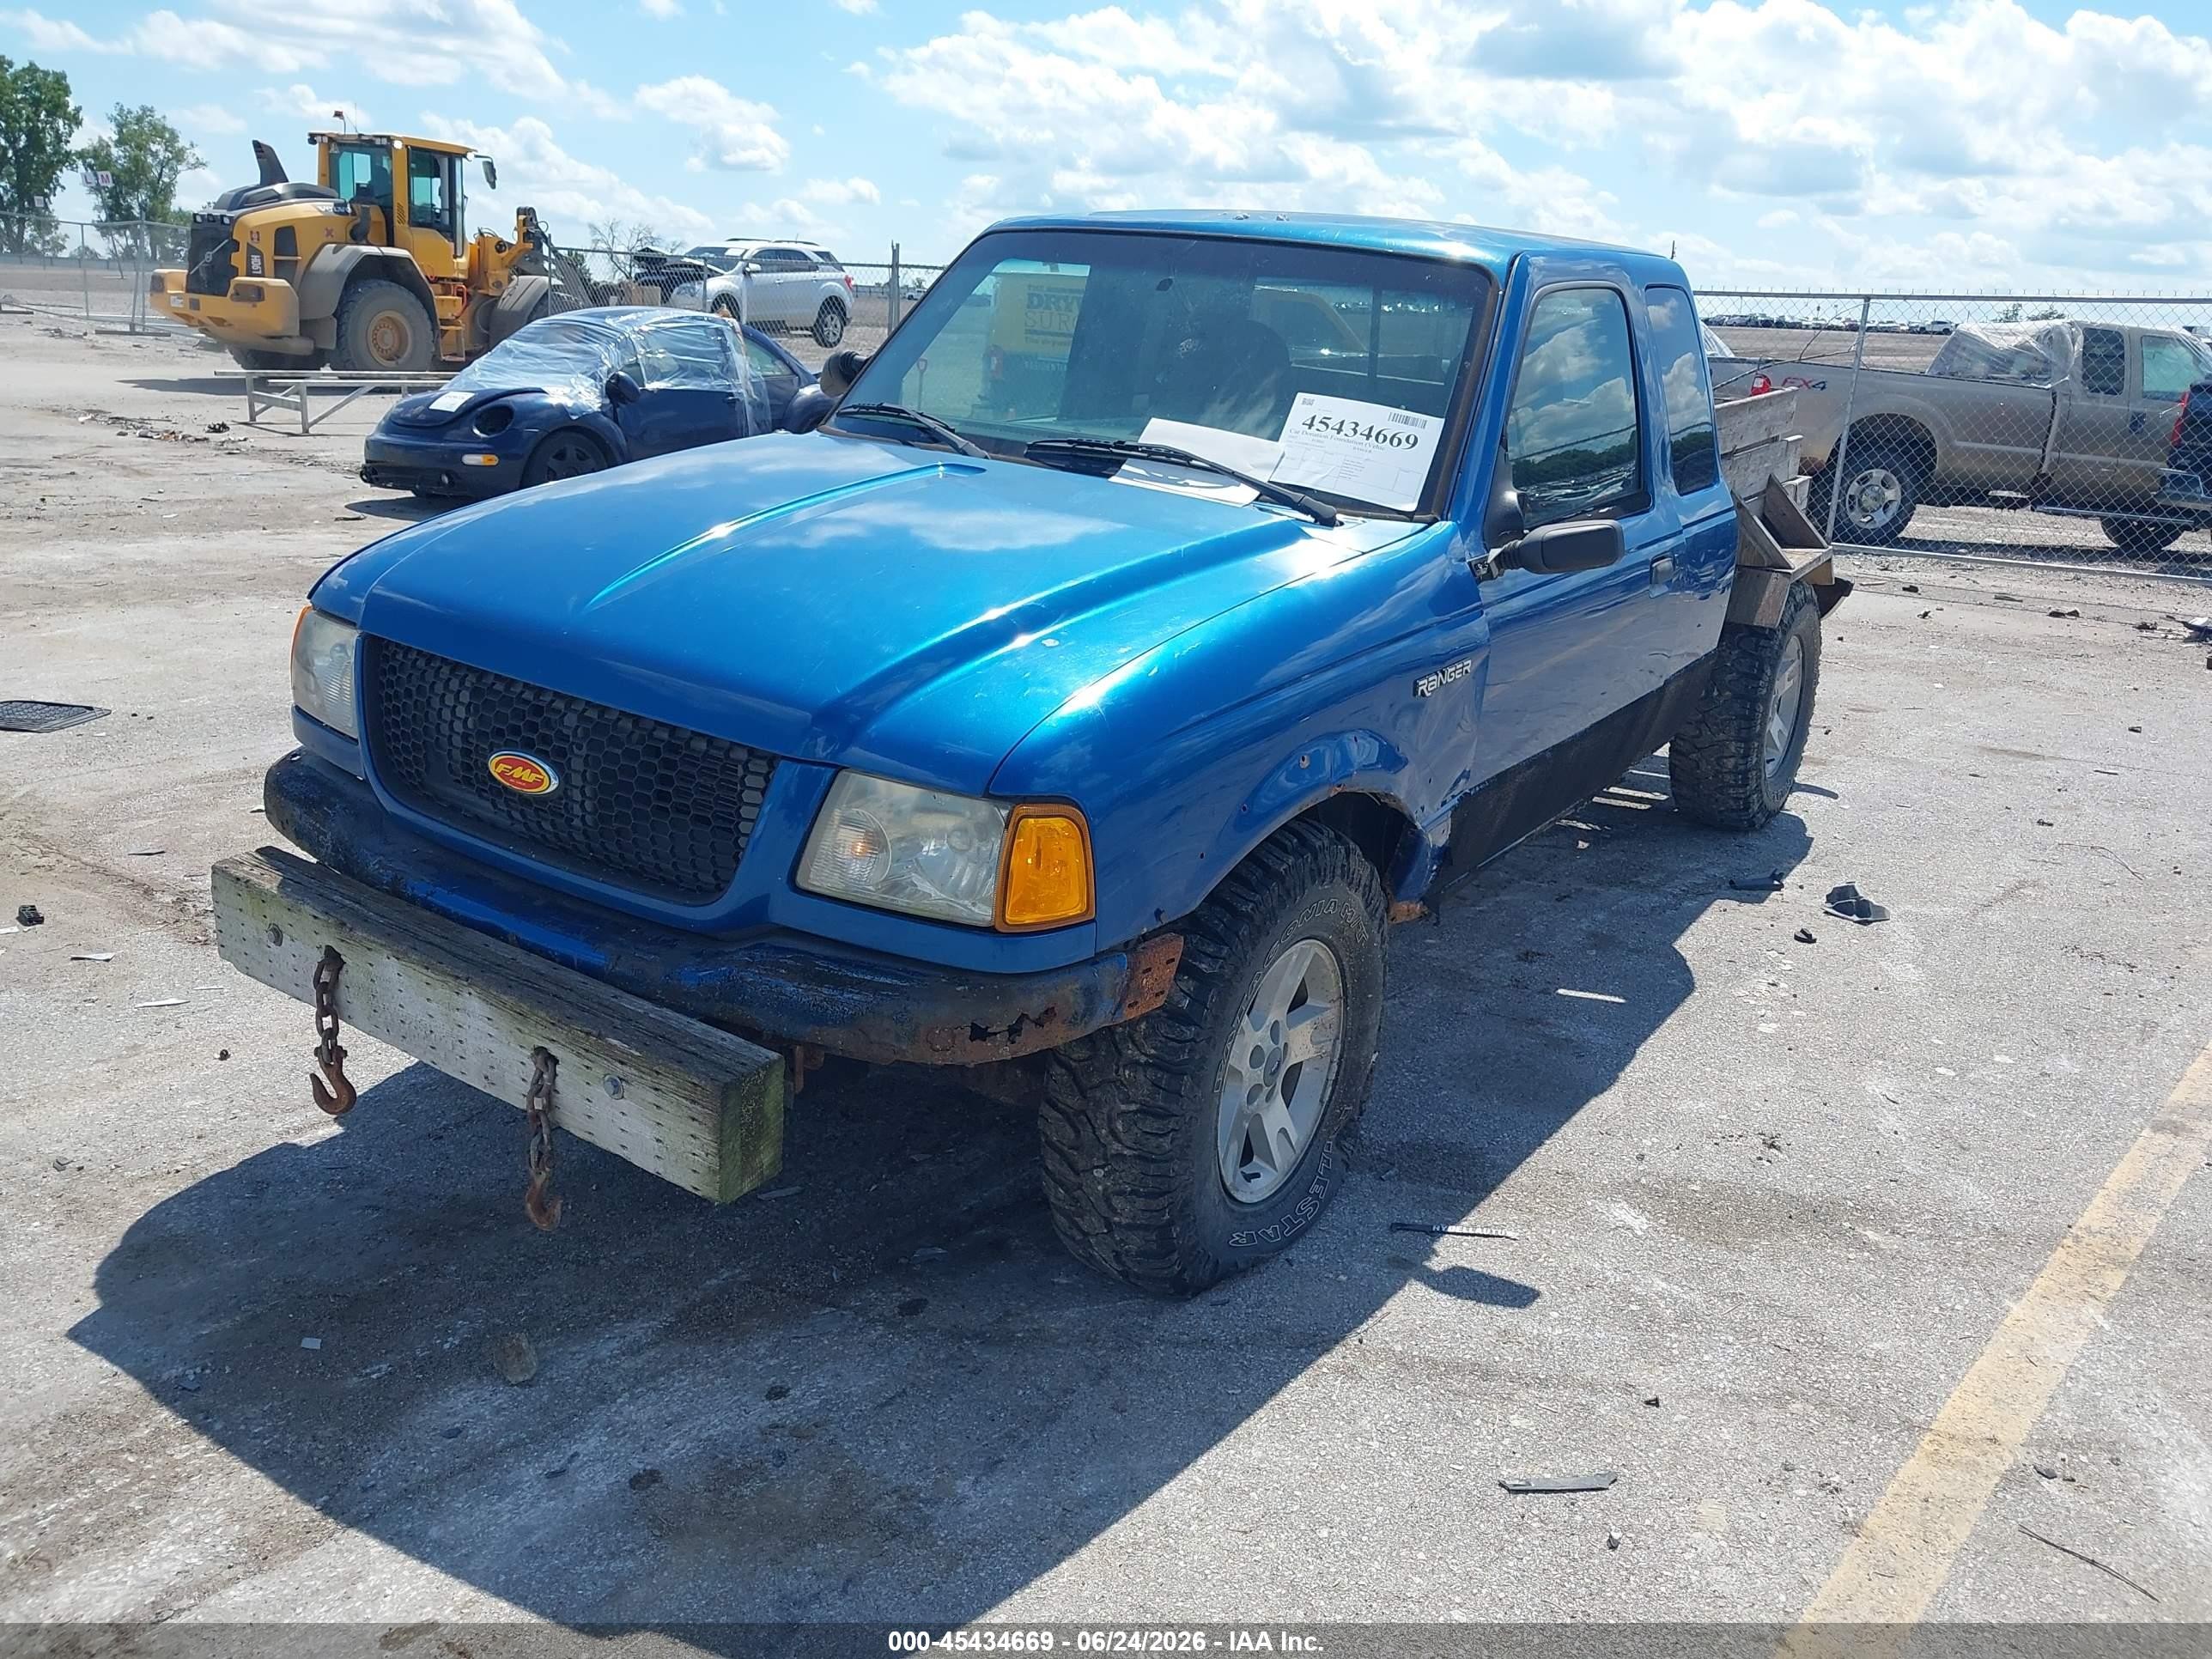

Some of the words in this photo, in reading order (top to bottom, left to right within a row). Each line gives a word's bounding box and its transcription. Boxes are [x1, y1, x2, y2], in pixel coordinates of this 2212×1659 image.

[251, 254, 262, 274] L90H
[1781, 376, 1827, 391] FX4
[1301, 414, 1419, 451] 45434669
[495, 763, 544, 782] FMF
